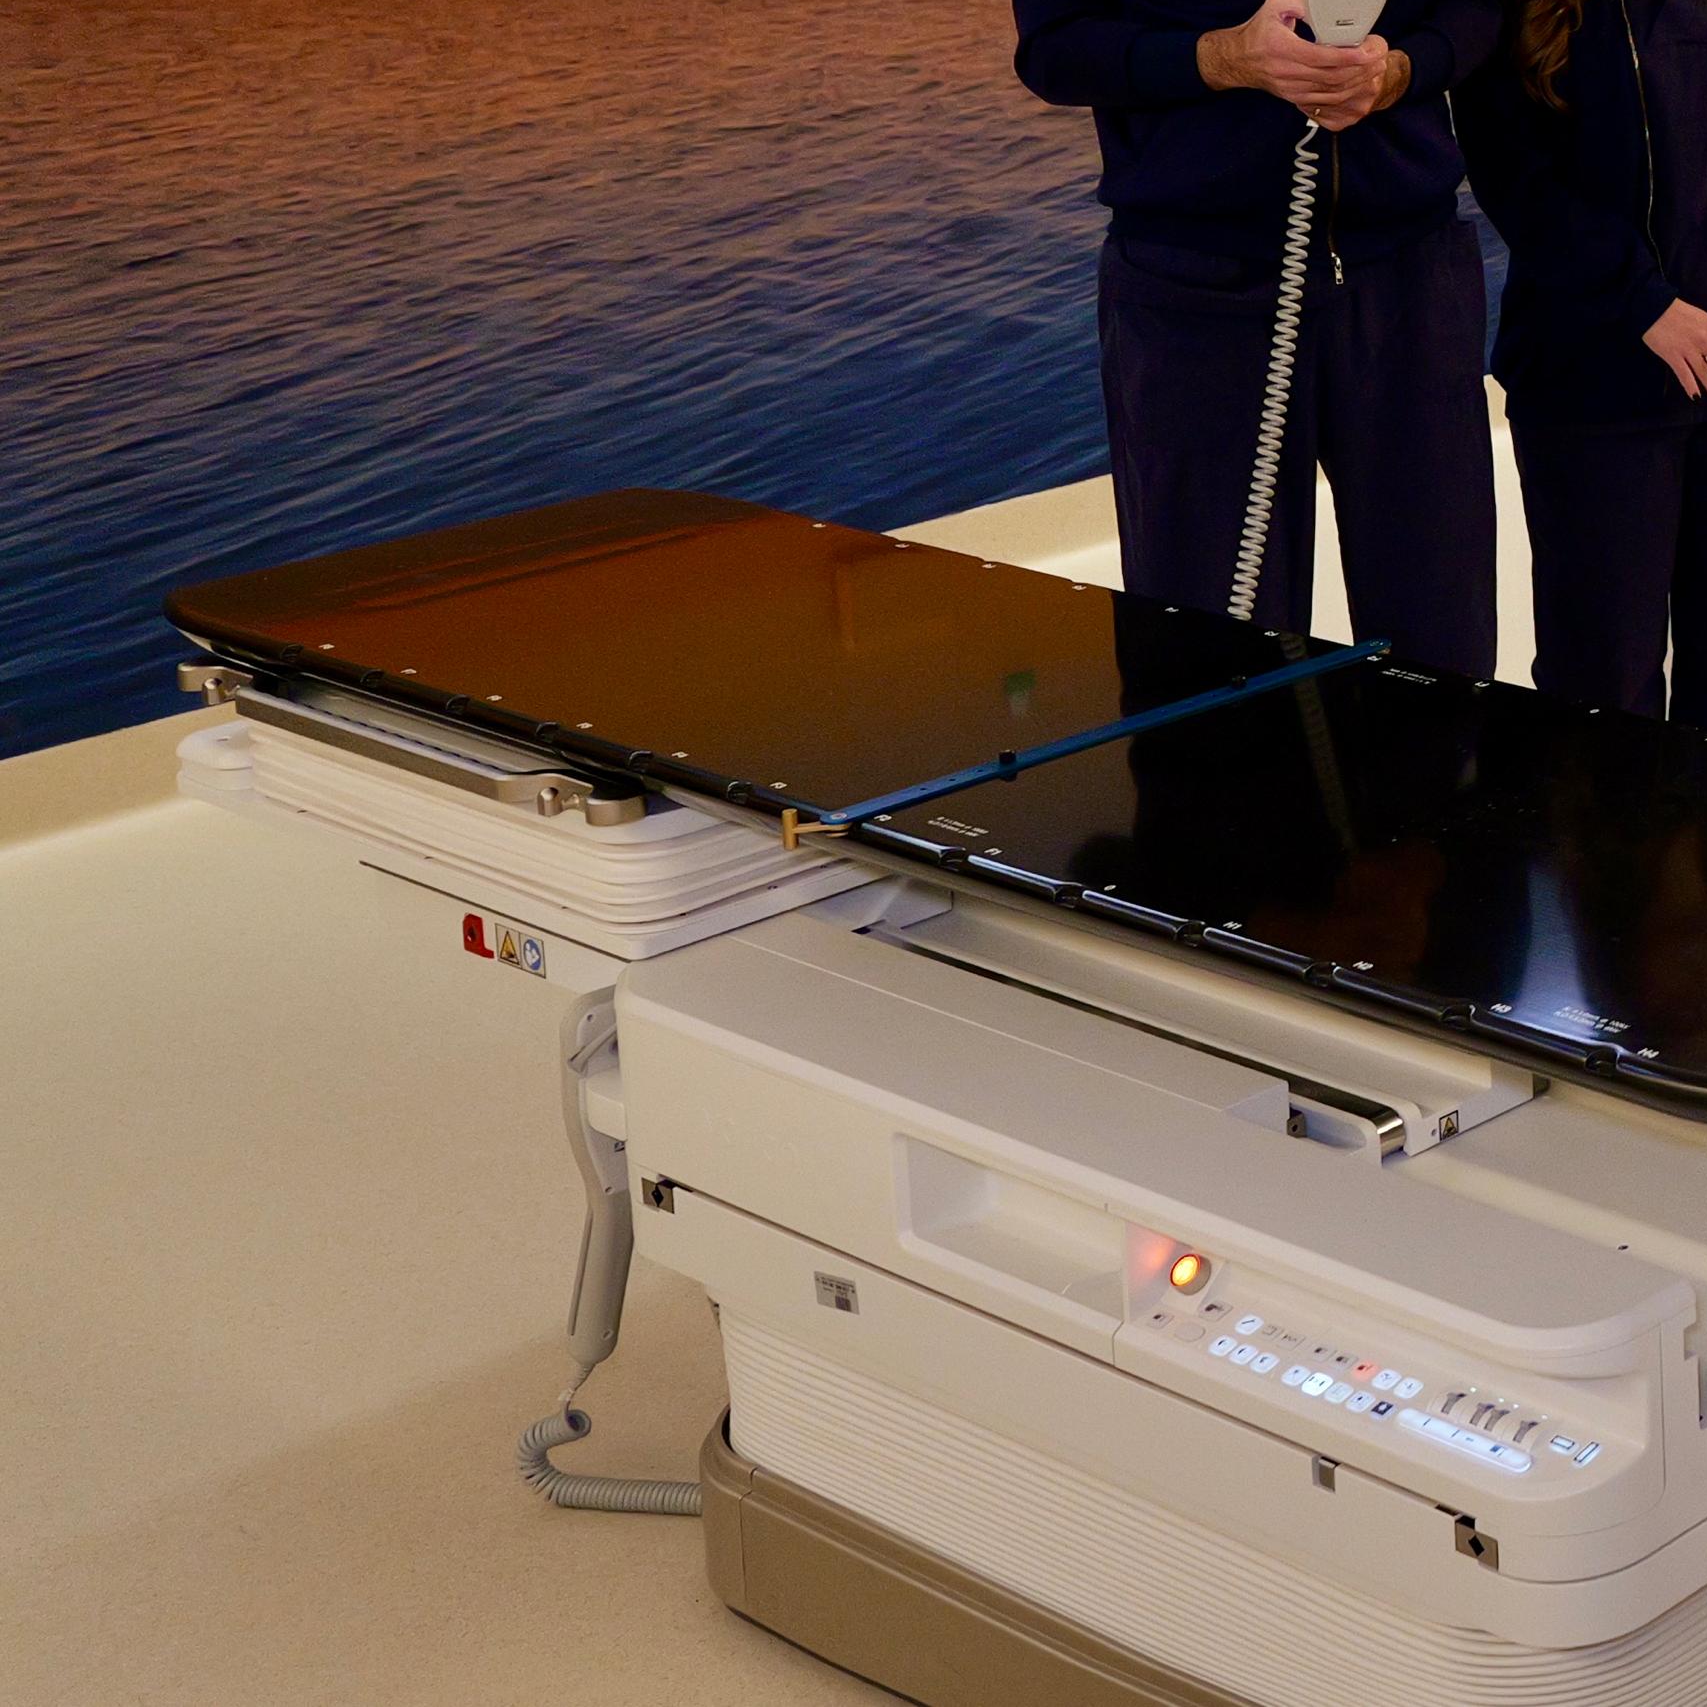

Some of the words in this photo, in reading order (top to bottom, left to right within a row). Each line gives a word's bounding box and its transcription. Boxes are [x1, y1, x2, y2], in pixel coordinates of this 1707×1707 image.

[1222, 921, 1243, 930] H1
[1352, 960, 1374, 971] H2
[1490, 1003, 1513, 1013] H3
[1636, 1047, 1660, 1059] H4
